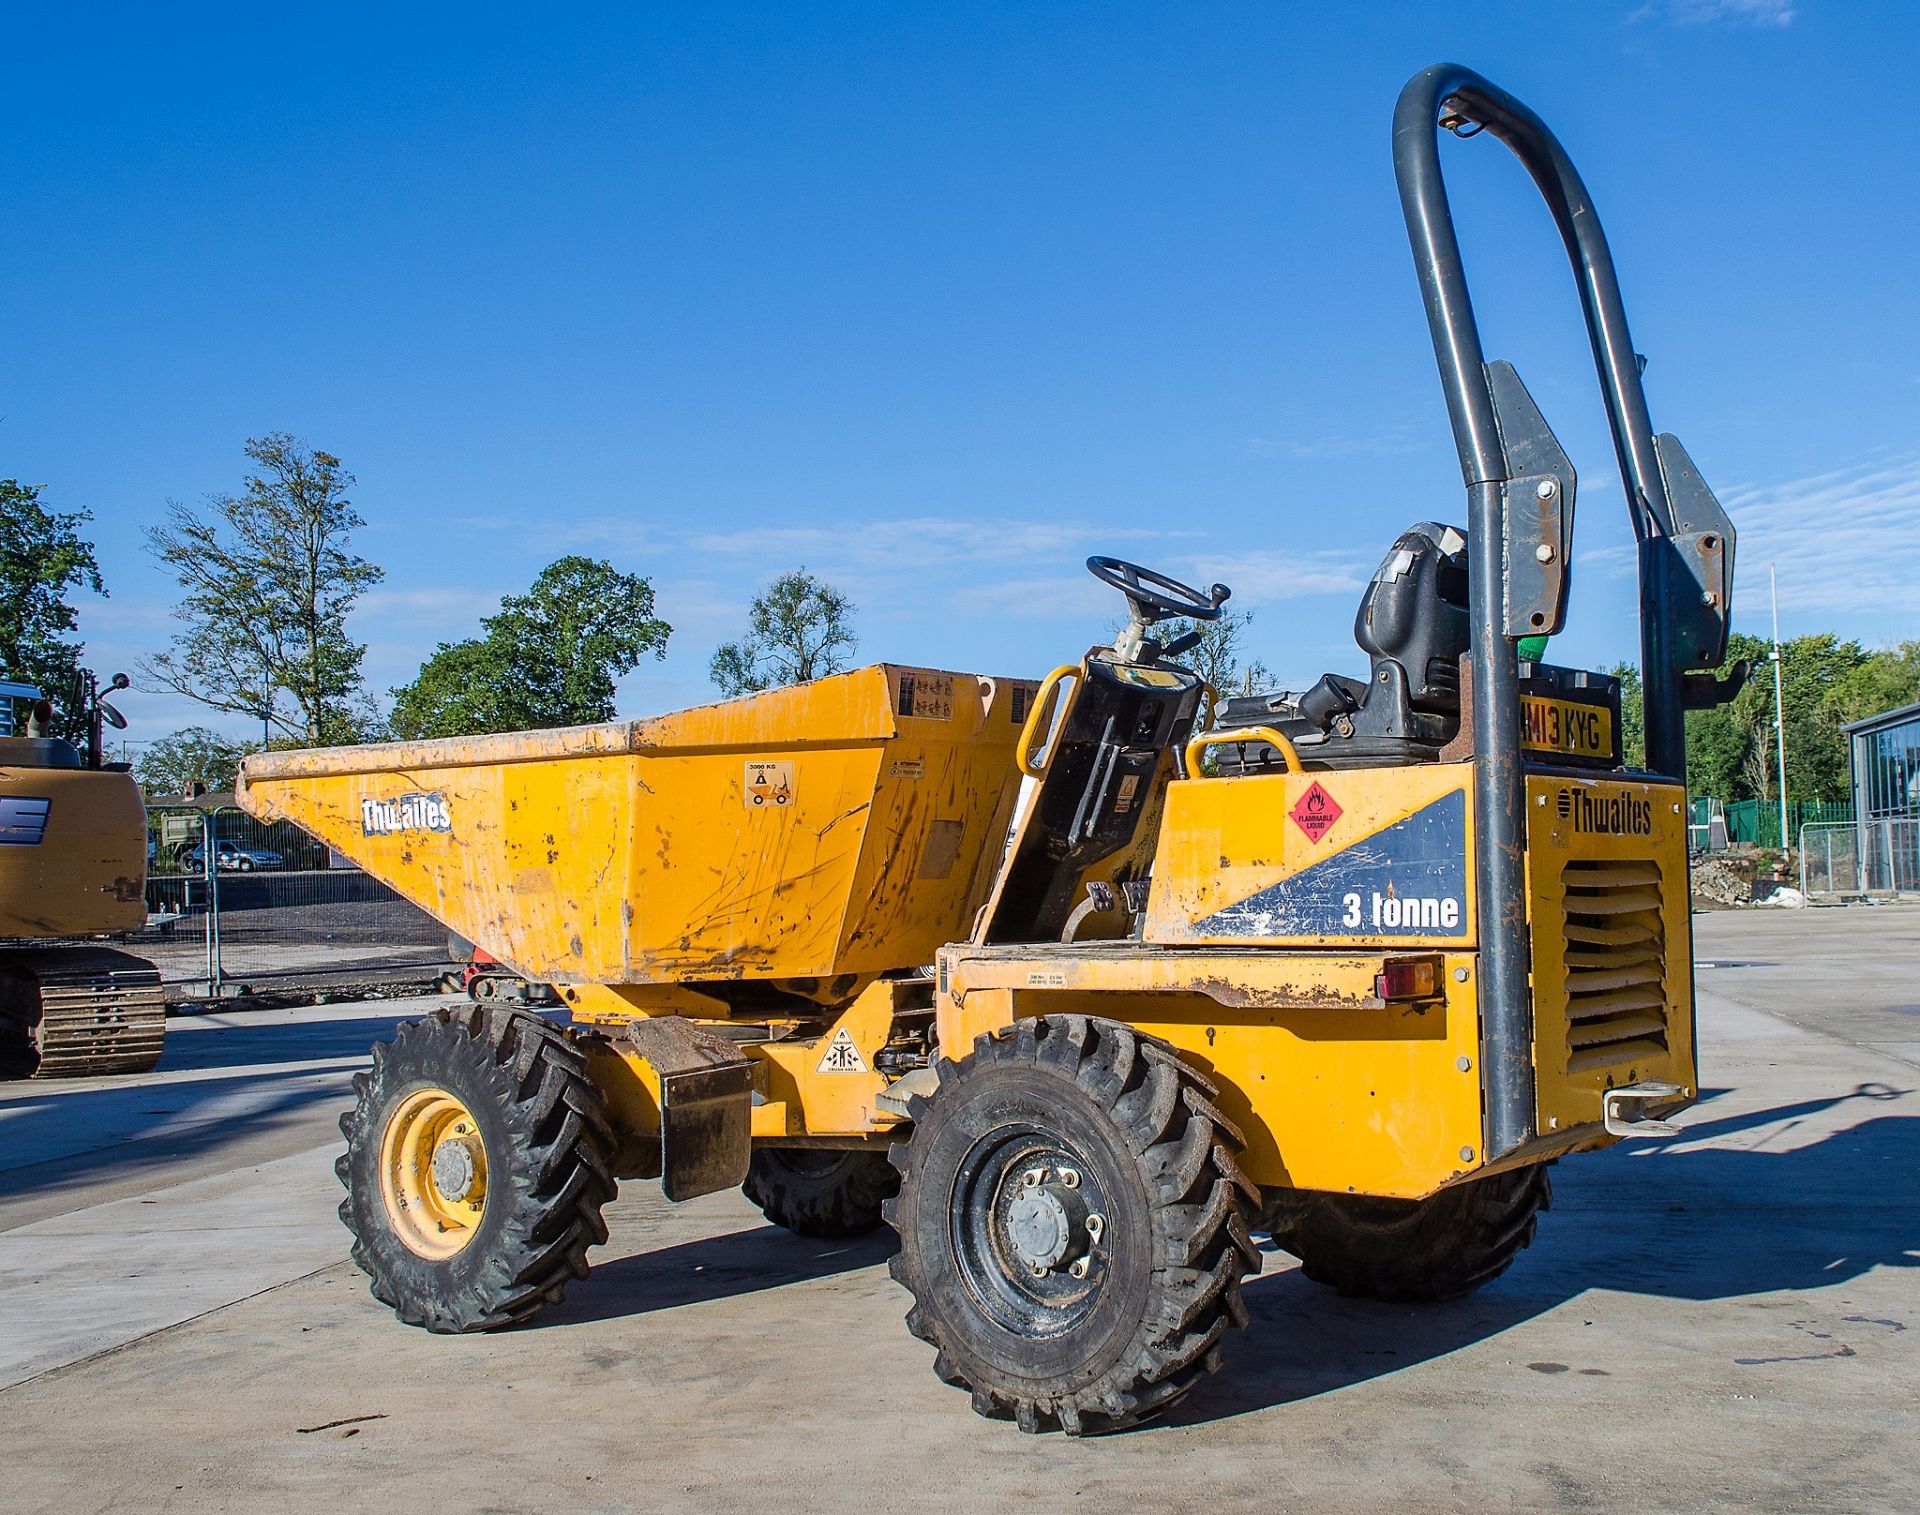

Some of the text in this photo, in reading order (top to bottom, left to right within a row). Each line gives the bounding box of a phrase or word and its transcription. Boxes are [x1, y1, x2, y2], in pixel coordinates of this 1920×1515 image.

[1565, 707, 1600, 750] KYG
[362, 796, 451, 832] Thwaites
[1571, 787, 1651, 835] Thwaites
[1313, 831, 1318, 839] 3
[1343, 892, 1459, 929] 3 tonne
